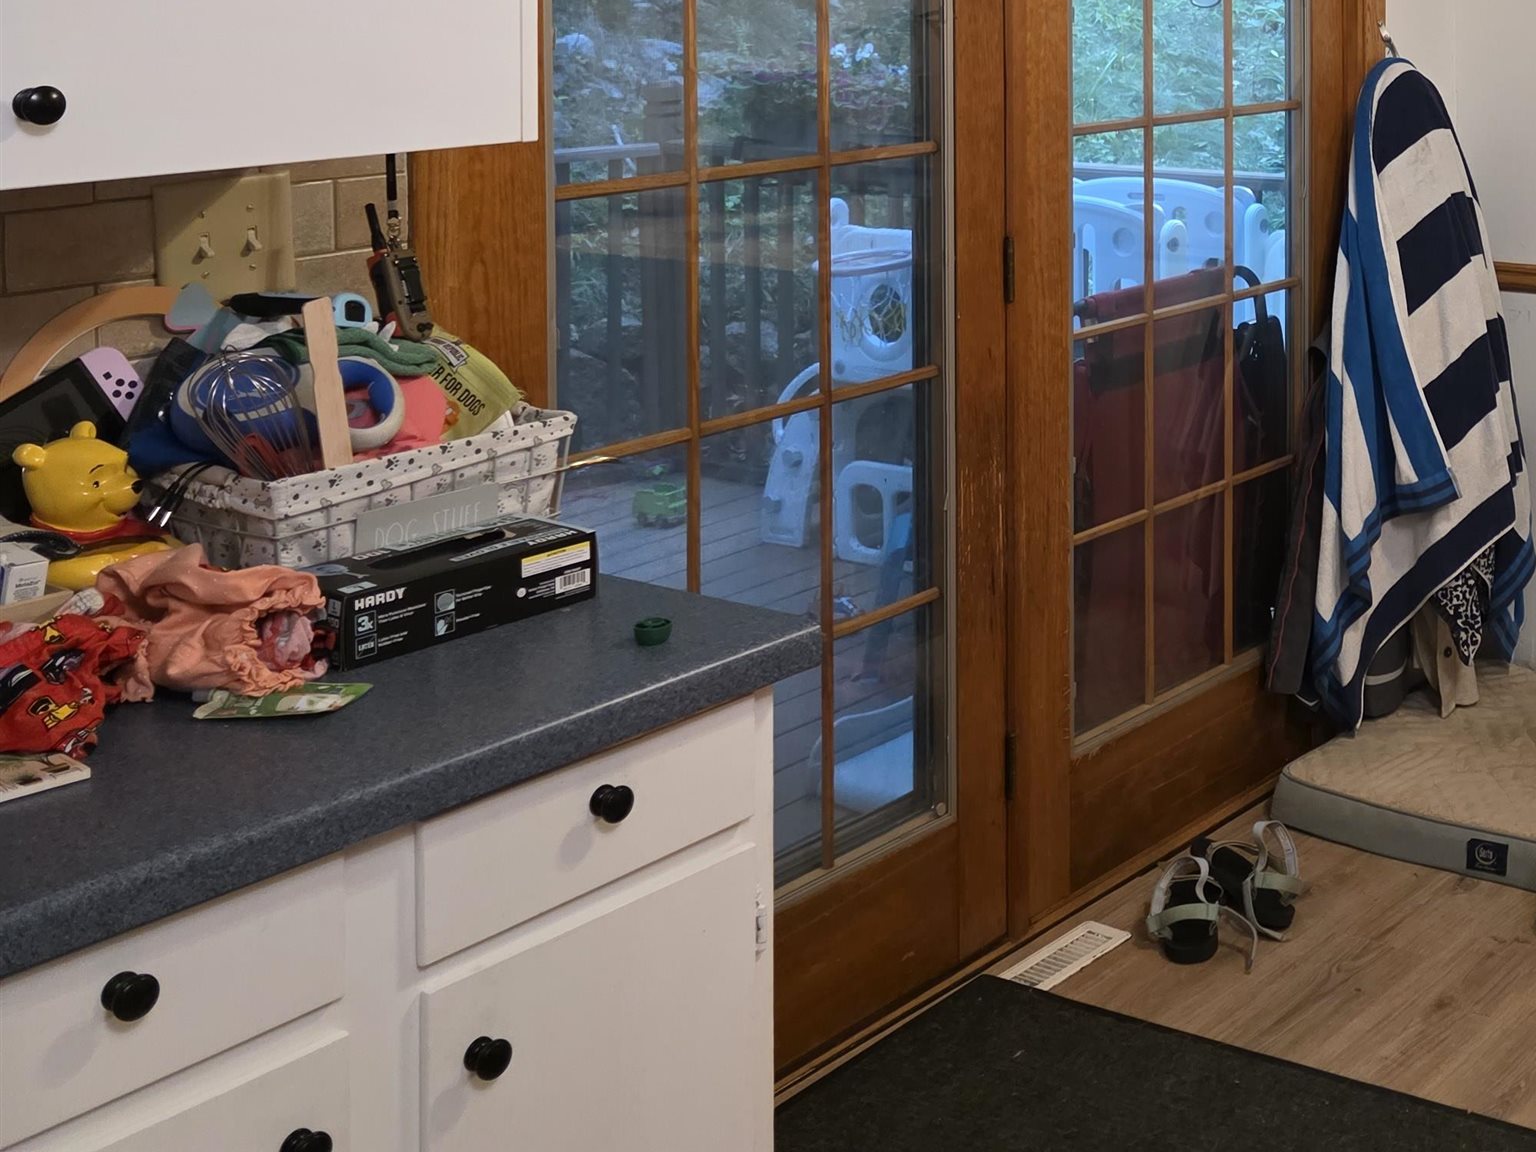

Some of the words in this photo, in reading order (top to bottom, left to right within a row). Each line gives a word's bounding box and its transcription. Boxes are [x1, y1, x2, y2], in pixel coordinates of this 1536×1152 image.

[439, 372, 463, 396] FOR
[457, 388, 486, 416] DOGS
[375, 519, 418, 549] DOG
[433, 501, 481, 535] STUFF
[354, 587, 408, 611] HARDY
